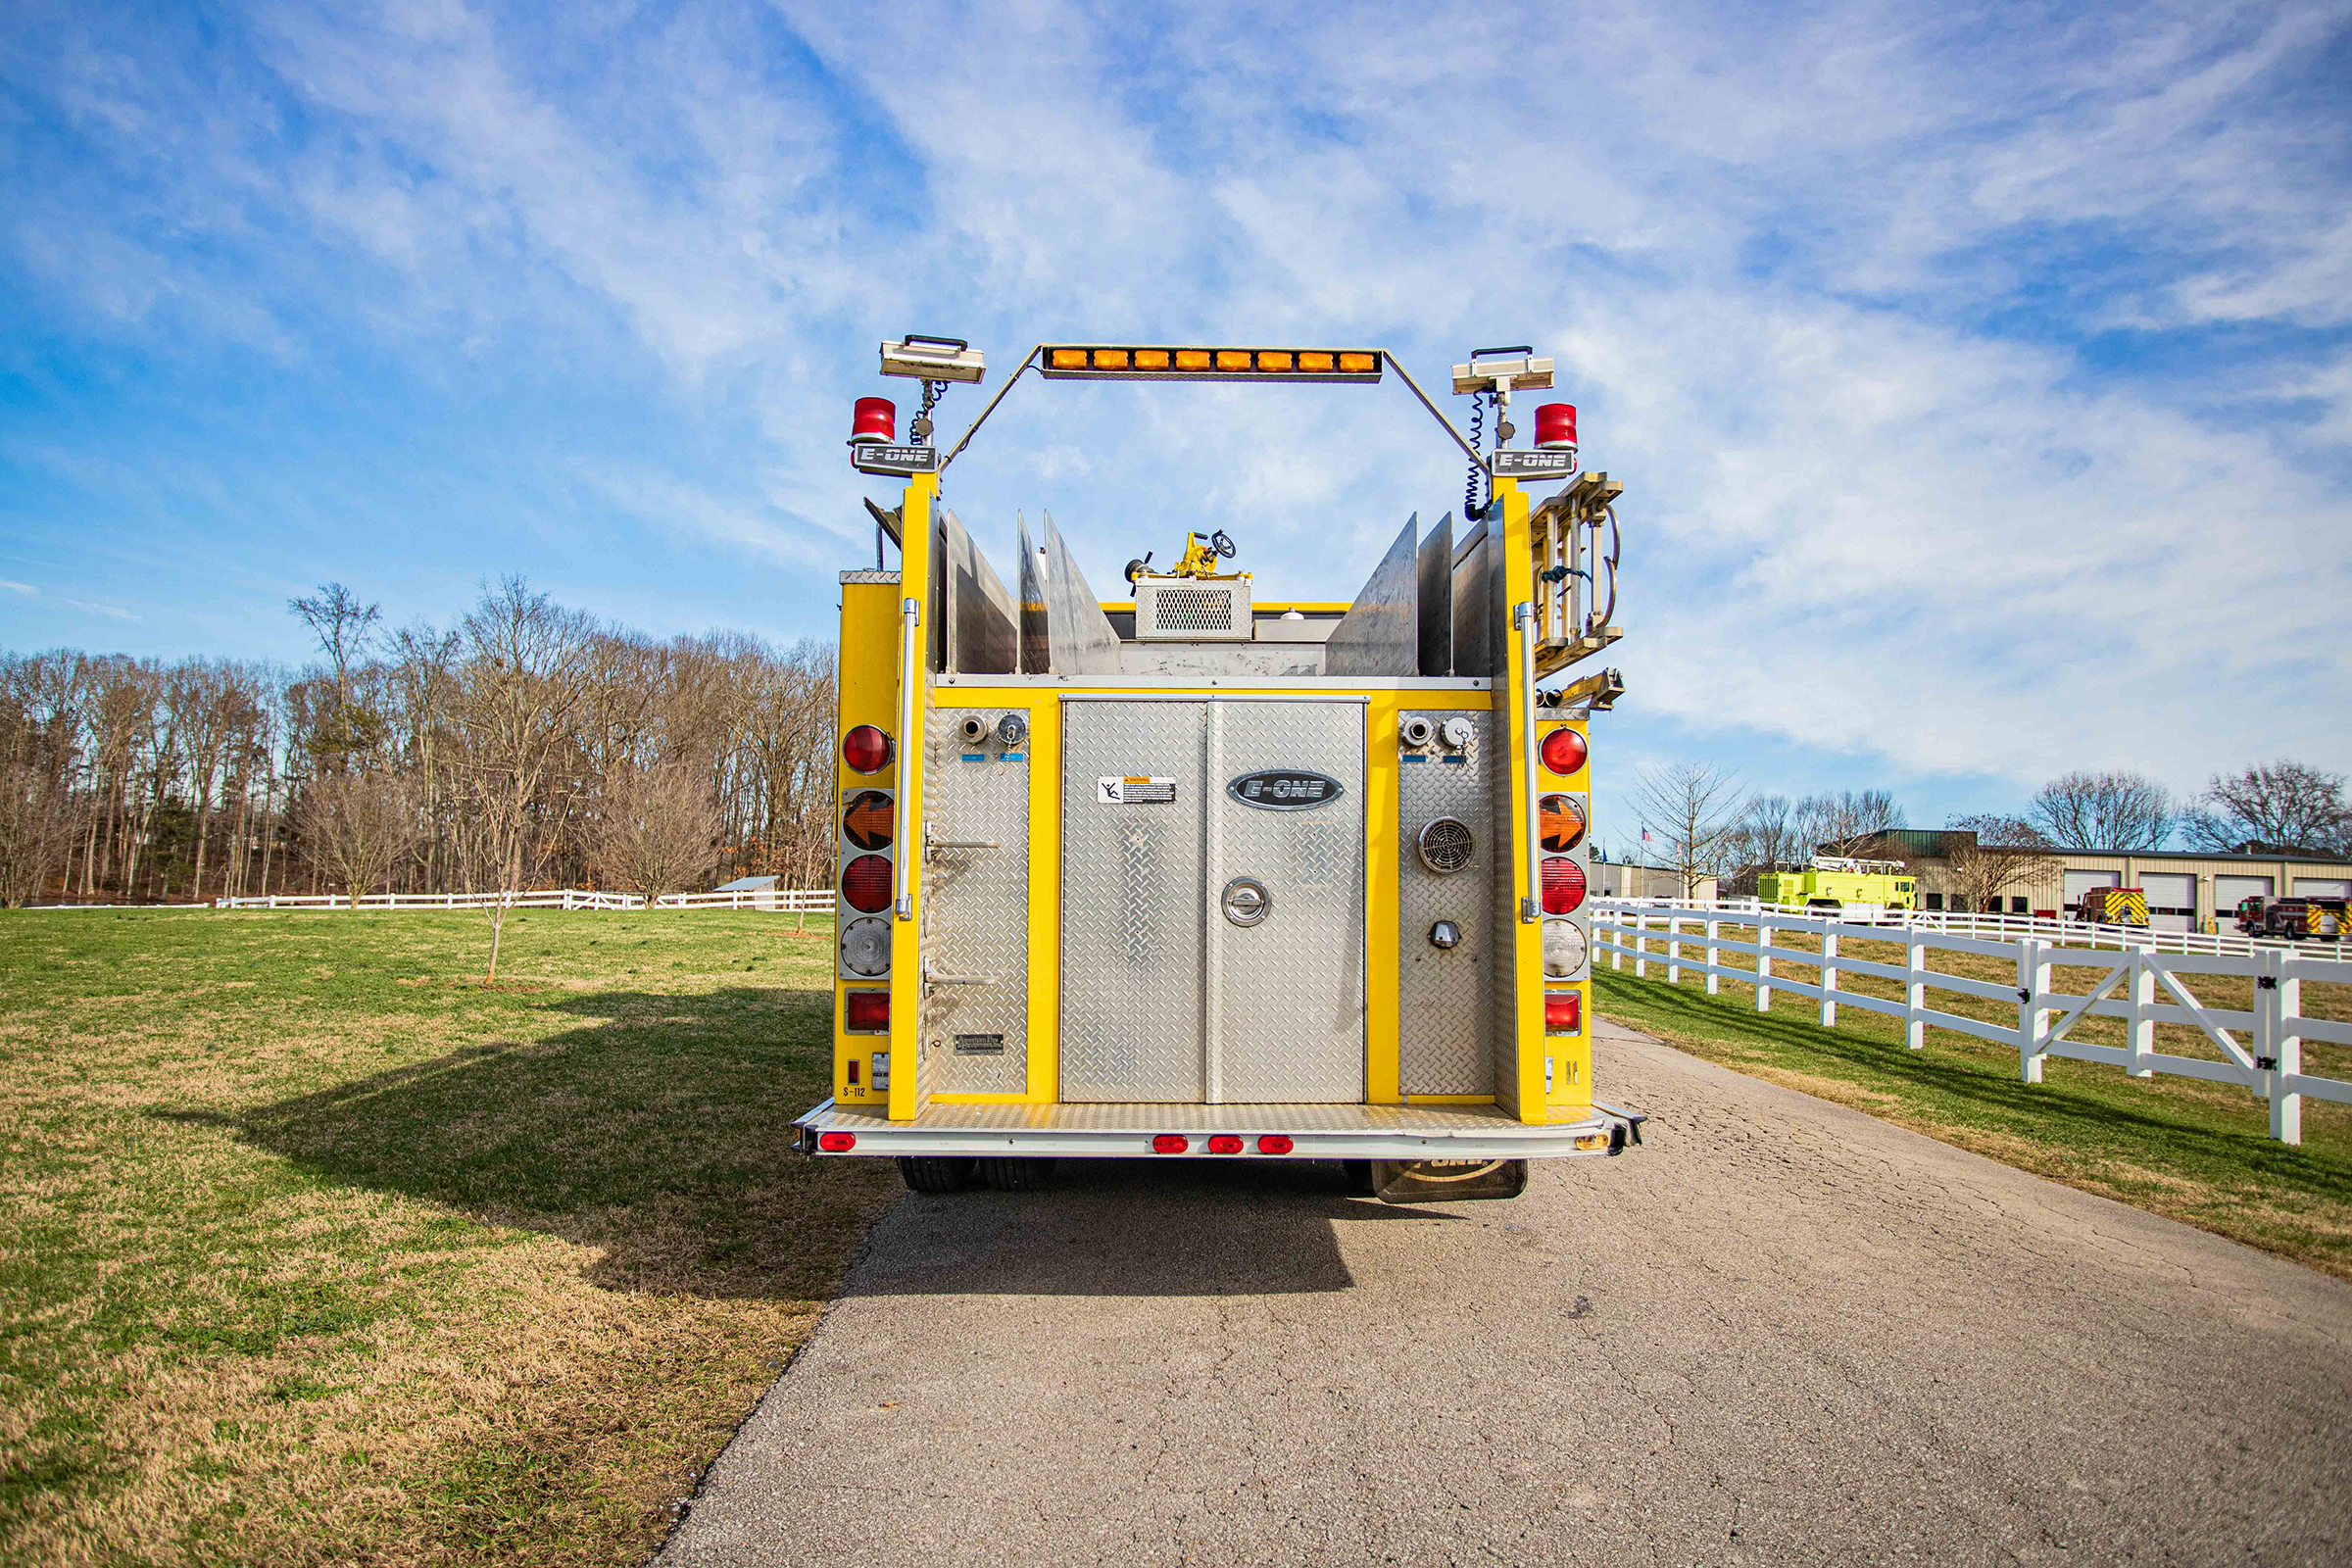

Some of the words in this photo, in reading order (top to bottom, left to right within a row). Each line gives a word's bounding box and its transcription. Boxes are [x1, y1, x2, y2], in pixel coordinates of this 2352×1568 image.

[860, 448, 929, 462] E-ONE
[1498, 454, 1566, 467] E-ONE
[1244, 779, 1326, 798] E-ONE
[843, 1087, 865, 1097] S-112
